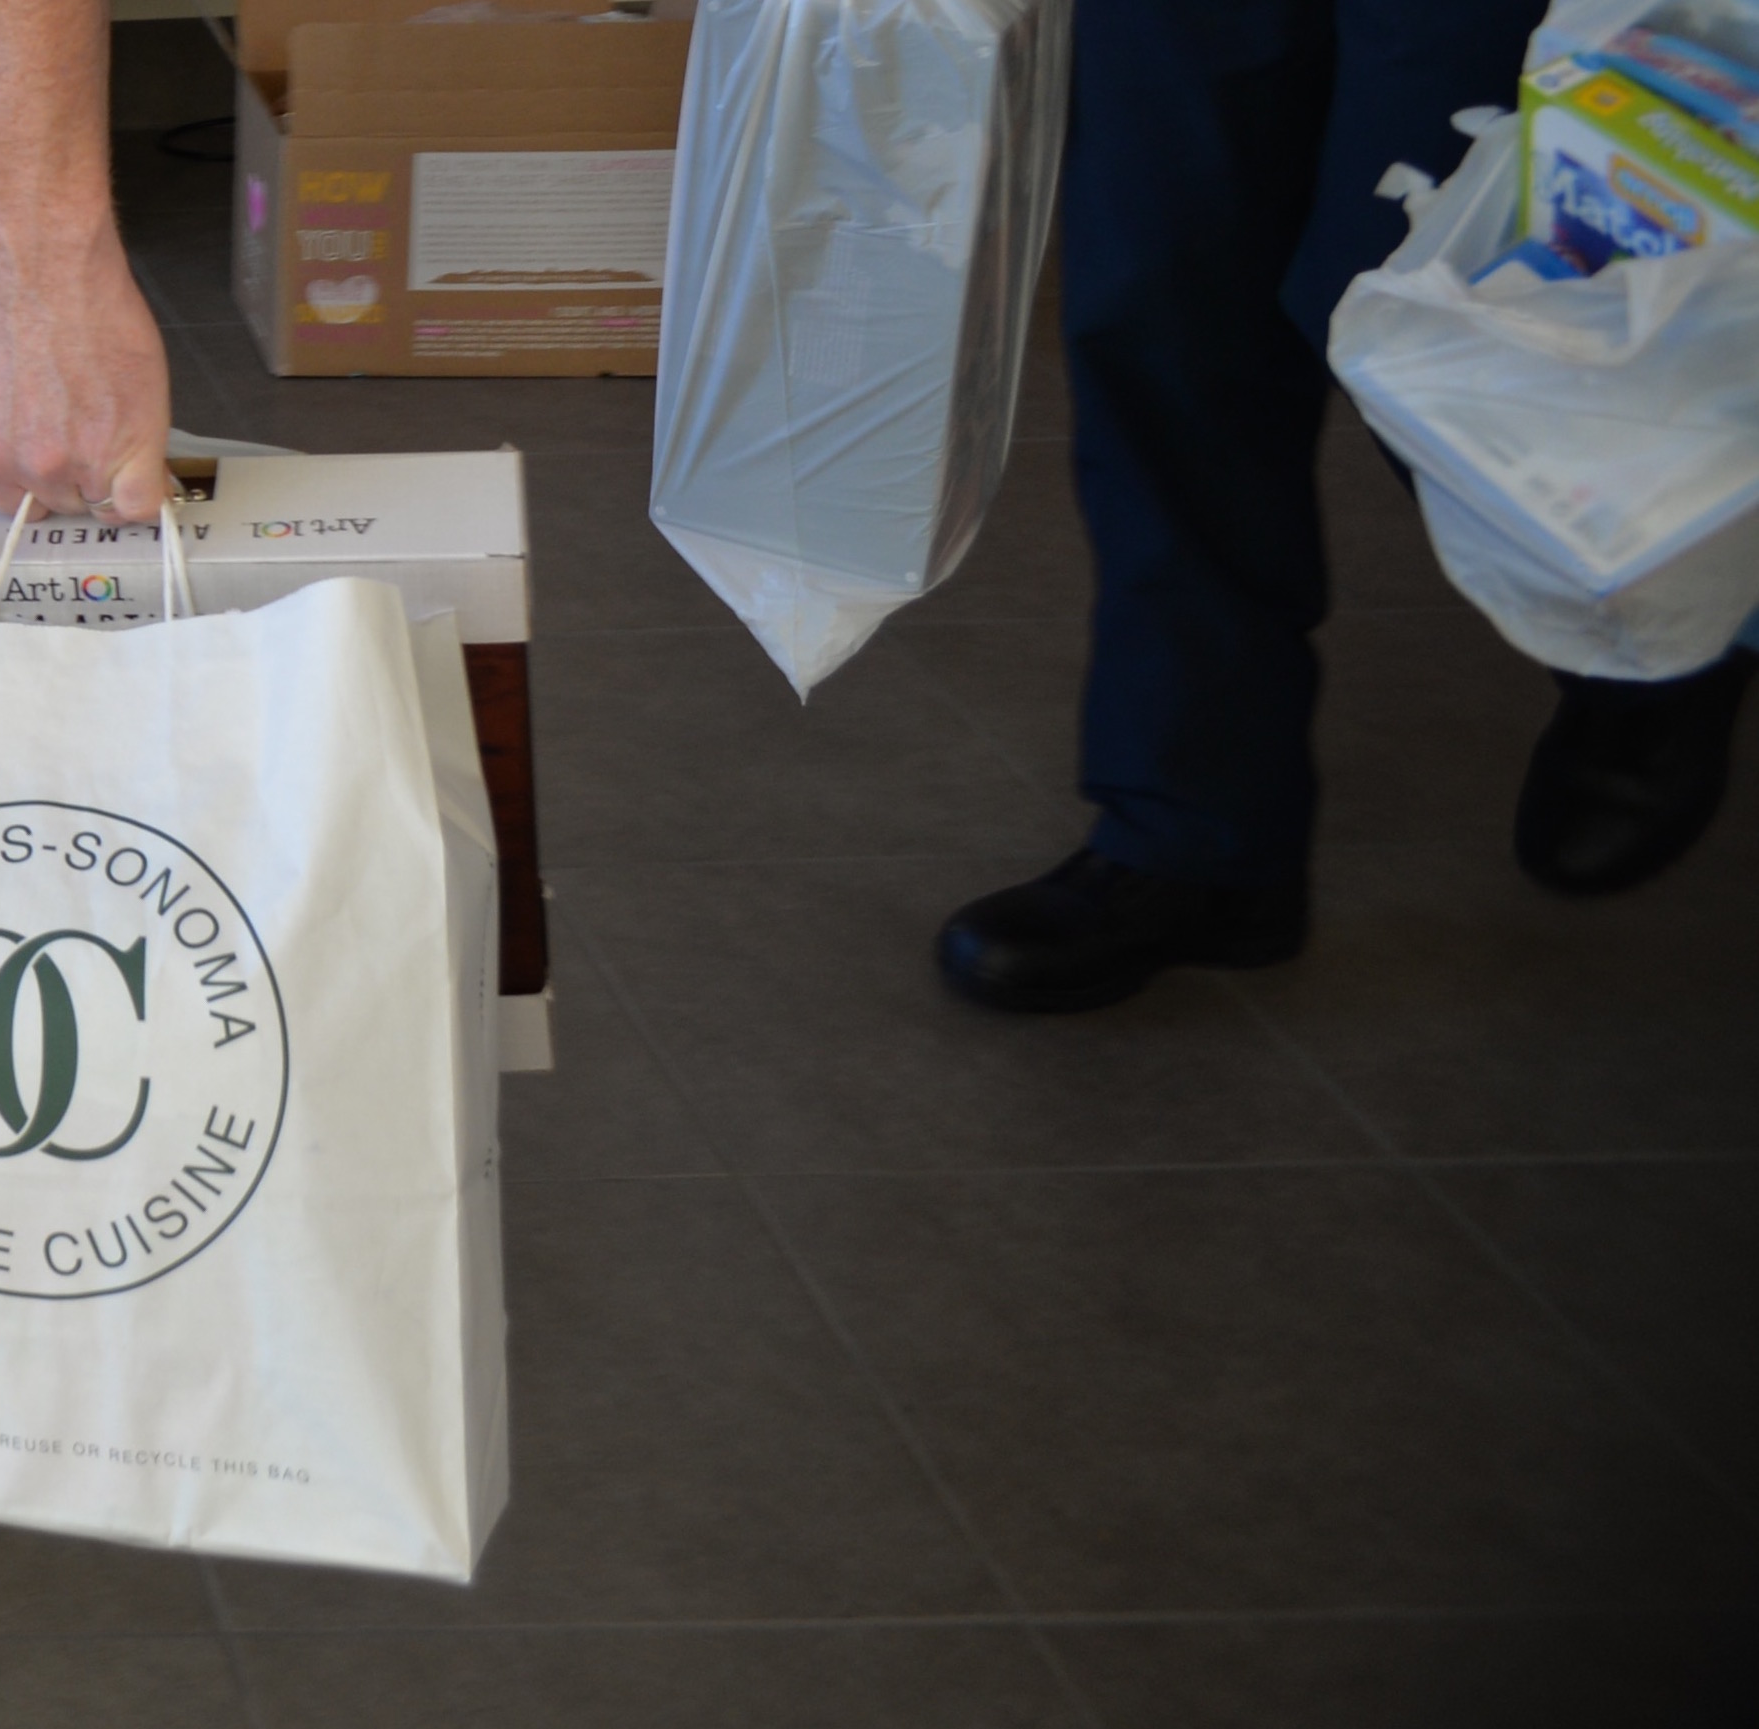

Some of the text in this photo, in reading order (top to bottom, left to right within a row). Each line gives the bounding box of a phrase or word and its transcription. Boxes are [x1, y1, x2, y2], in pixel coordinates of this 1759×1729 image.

[43, 1104, 256, 1277] CUISINE
[72, 1441, 100, 1459] OR
[108, 1447, 202, 1472] RECYCLE
[210, 1458, 258, 1477] THIS
[268, 1465, 310, 1485] BAG
